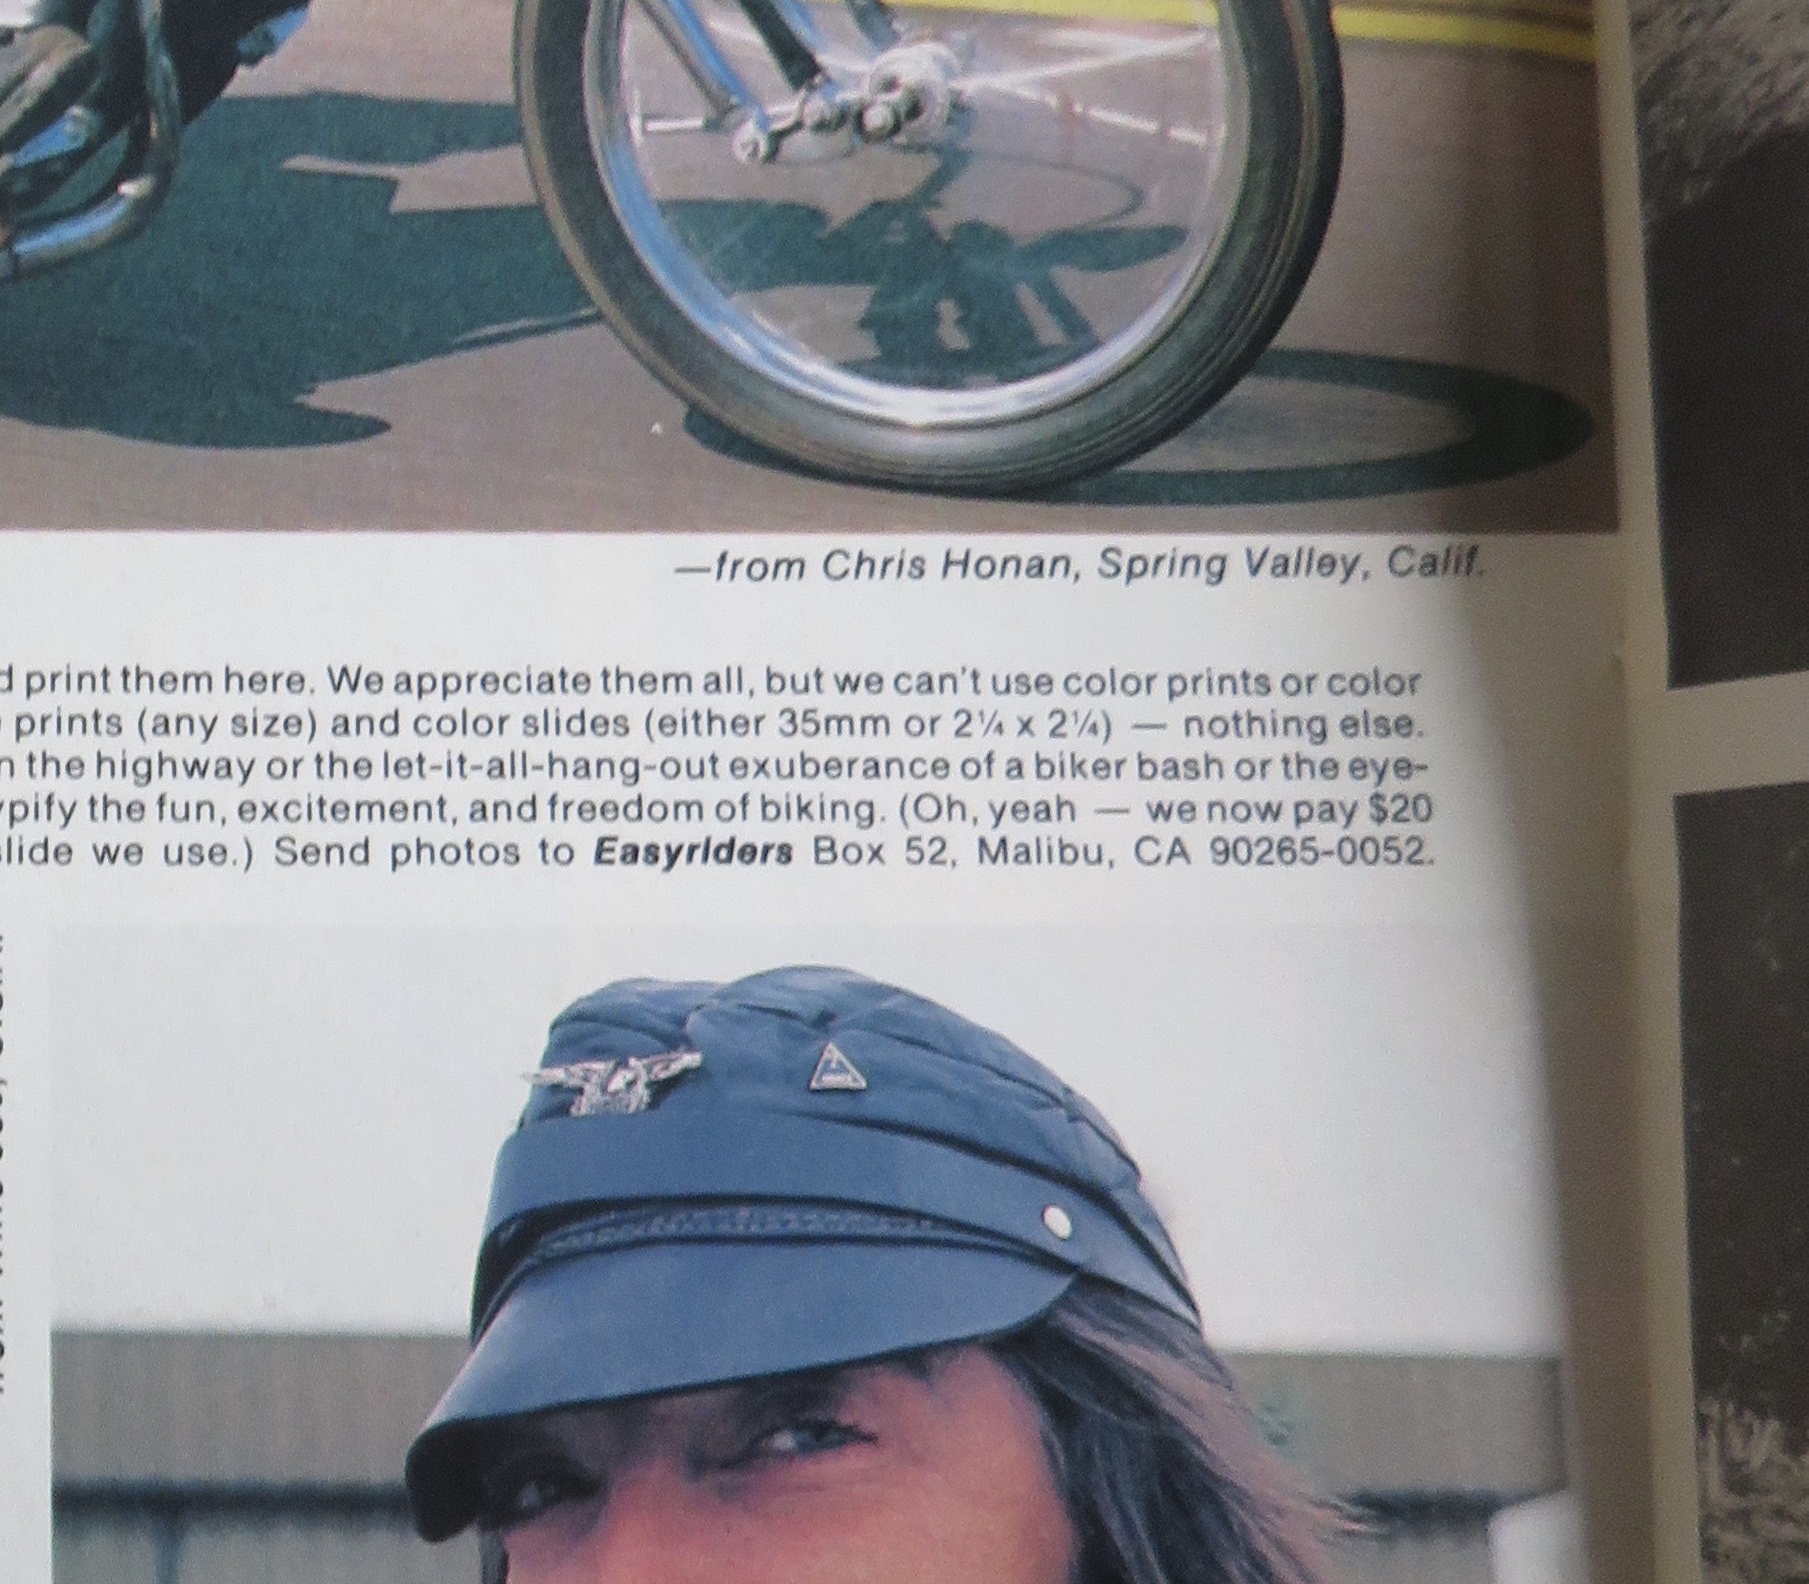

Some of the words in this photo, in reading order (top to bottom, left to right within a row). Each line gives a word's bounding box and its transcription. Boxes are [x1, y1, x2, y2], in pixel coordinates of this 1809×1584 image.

[822, 547, 926, 582] Chris
[941, 546, 1081, 583] Honan,
[1097, 545, 1228, 587] Spring
[1245, 544, 1370, 585] Valley,
[1387, 542, 1485, 578] Calif.
[25, 664, 111, 701] print
[120, 663, 214, 695] them
[224, 664, 315, 695] here.
[326, 664, 384, 695] We
[393, 665, 592, 702] appreciate
[600, 665, 693, 695] them
[702, 665, 755, 698] all,
[765, 665, 824, 695] but
[833, 671, 885, 695] we
[893, 666, 981, 696] can't
[991, 672, 1054, 696] use
[1063, 667, 1158, 697] color
[1167, 667, 1272, 703] prints
[1280, 672, 1319, 697] or
[1326, 666, 1422, 697] color
[14, 706, 123, 744] prints
[137, 707, 219, 745] (any
[230, 706, 317, 744] size)
[331, 707, 400, 738] and
[412, 707, 511, 738] color
[522, 707, 631, 738] slides
[644, 707, 767, 743] (either
[779, 707, 891, 738] 35mm
[903, 714, 942, 738] or
[1017, 716, 1035, 737] x
[1184, 708, 1329, 746] nothing
[1339, 708, 1423, 739] else.
[26, 749, 86, 780] the
[96, 749, 256, 788] highway
[266, 756, 304, 781] or
[314, 749, 374, 781] the
[383, 749, 720, 788] let-it-all-hang-out
[728, 750, 951, 780] exuberance
[960, 749, 995, 781] of
[1005, 757, 1025, 781] a
[1034, 751, 1127, 781] biker
[1136, 751, 1225, 781] bash
[1234, 757, 1273, 782] or
[1280, 751, 1340, 781] the
[1348, 756, 1429, 788] eye-
[87, 792, 146, 823] the
[156, 792, 227, 827] fun,
[237, 793, 458, 827] excitement,
[468, 792, 538, 823] and
[547, 792, 704, 824] freedom
[714, 791, 750, 823] of
[760, 792, 886, 830] biking.
[899, 792, 978, 829] (Oh,
[988, 793, 1076, 830] yeah
[1146, 800, 1197, 824] we
[1207, 799, 1283, 824] now
[1293, 799, 1359, 830] pay
[1368, 791, 1433, 827] $20
[91, 842, 144, 866] we
[163, 837, 254, 873] use.)
[274, 835, 370, 867] Send
[390, 836, 521, 874] photos
[538, 837, 575, 867] to
[593, 835, 794, 874] Easyriders
[813, 834, 885, 866] Box
[905, 835, 957, 868] 52,
[977, 835, 1115, 869] Malibu,
[1134, 834, 1192, 867] CA
[1209, 834, 1435, 867] 90265-0052.
